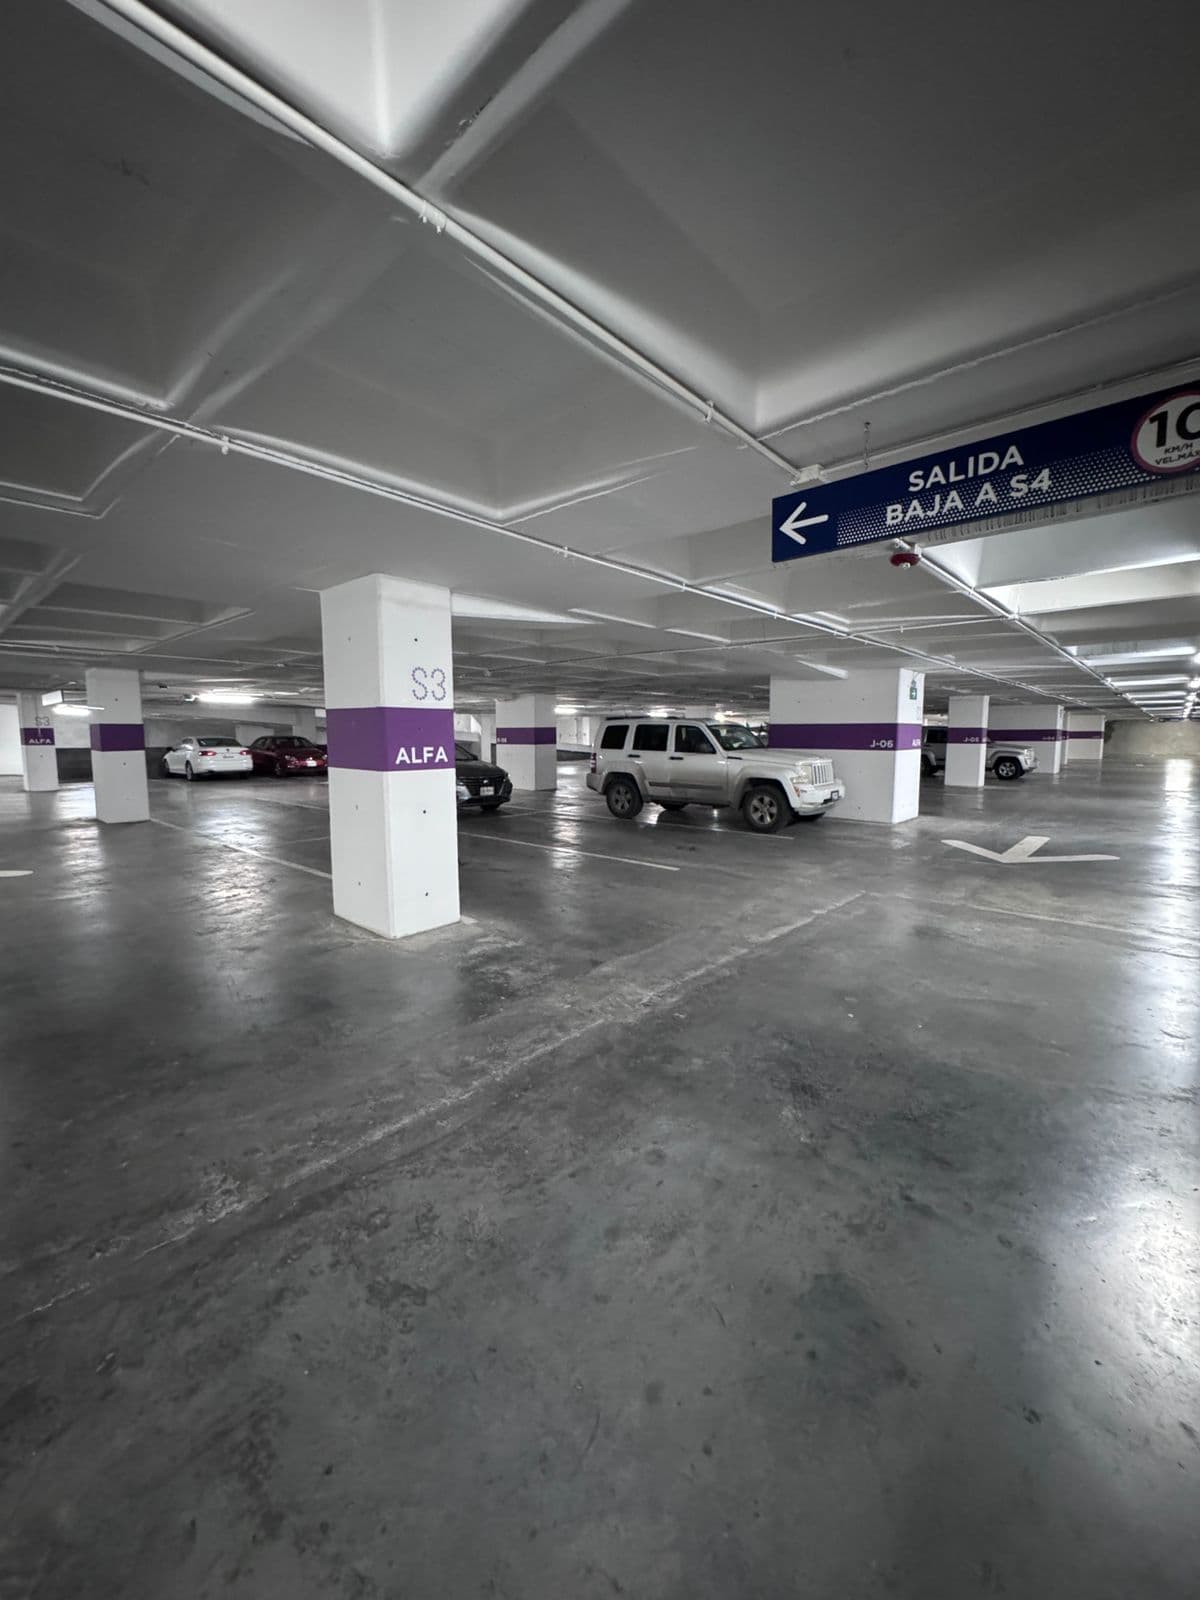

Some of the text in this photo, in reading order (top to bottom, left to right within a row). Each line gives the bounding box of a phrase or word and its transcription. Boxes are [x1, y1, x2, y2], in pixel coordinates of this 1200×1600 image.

[1164, 442, 1193, 454] KM/H
[908, 445, 1024, 492] SALIDA
[886, 468, 1051, 526] BAJA A S4
[412, 667, 446, 701] S3
[35, 716, 50, 726] S3
[870, 739, 893, 748] J-06
[395, 746, 448, 765] ALFA
